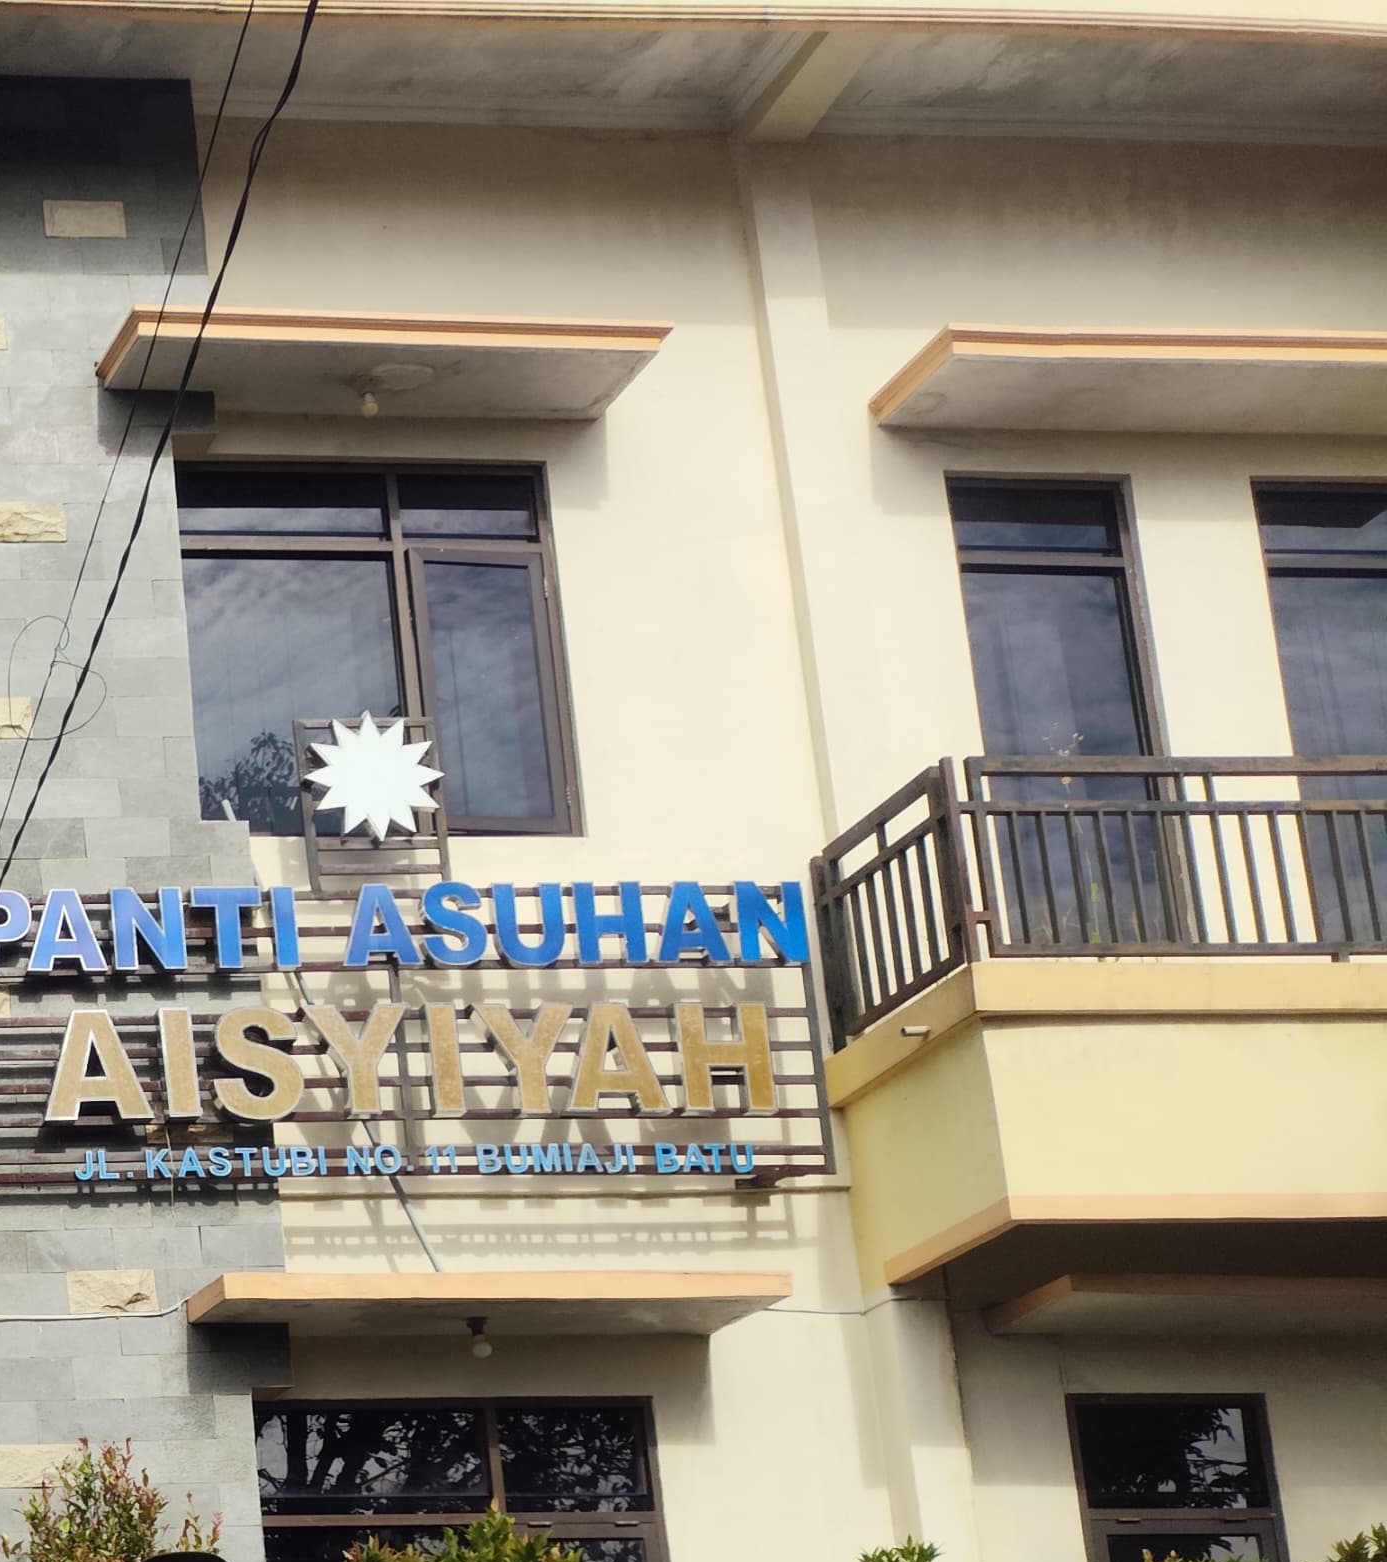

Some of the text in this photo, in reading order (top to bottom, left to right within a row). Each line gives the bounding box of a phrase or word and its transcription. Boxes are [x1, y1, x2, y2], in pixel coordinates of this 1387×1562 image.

[343, 880, 810, 969] ASUHAN
[44, 1003, 778, 1123] AISYIYAH
[74, 1142, 755, 1181] JL. KASTUBI NO. 11 BUMIAJI BATU
